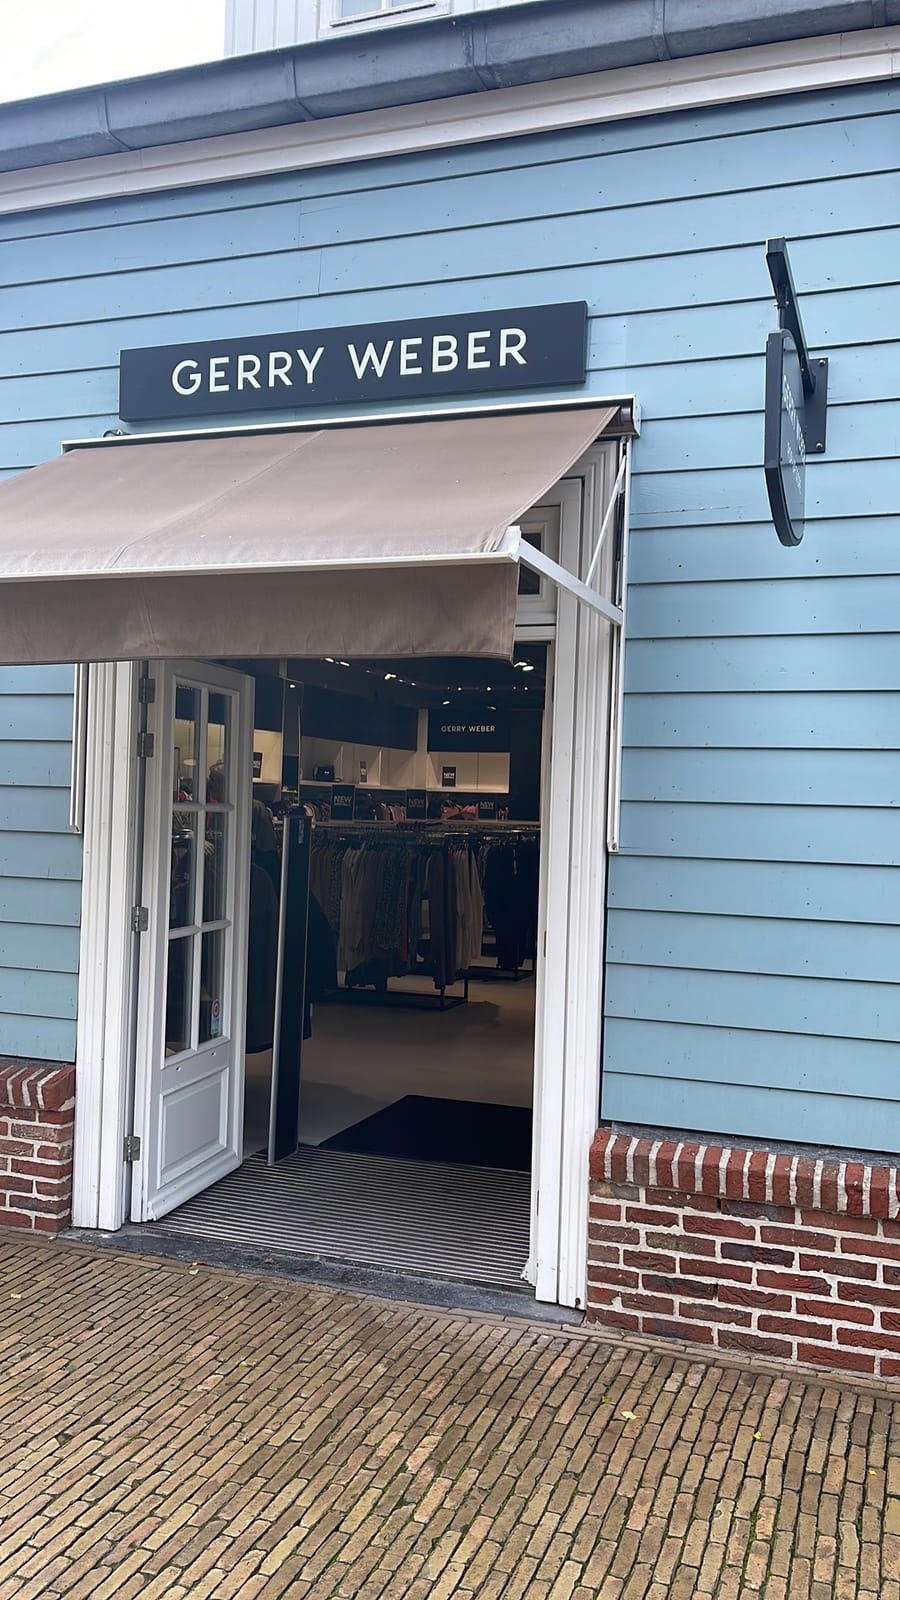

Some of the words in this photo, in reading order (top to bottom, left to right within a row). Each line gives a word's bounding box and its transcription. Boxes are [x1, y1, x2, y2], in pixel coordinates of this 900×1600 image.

[171, 346, 325, 396] GERRY
[347, 327, 528, 380] WEBER
[441, 725, 466, 733] GERRY
[468, 725, 495, 733] WEBER
[333, 795, 352, 803] NEW
